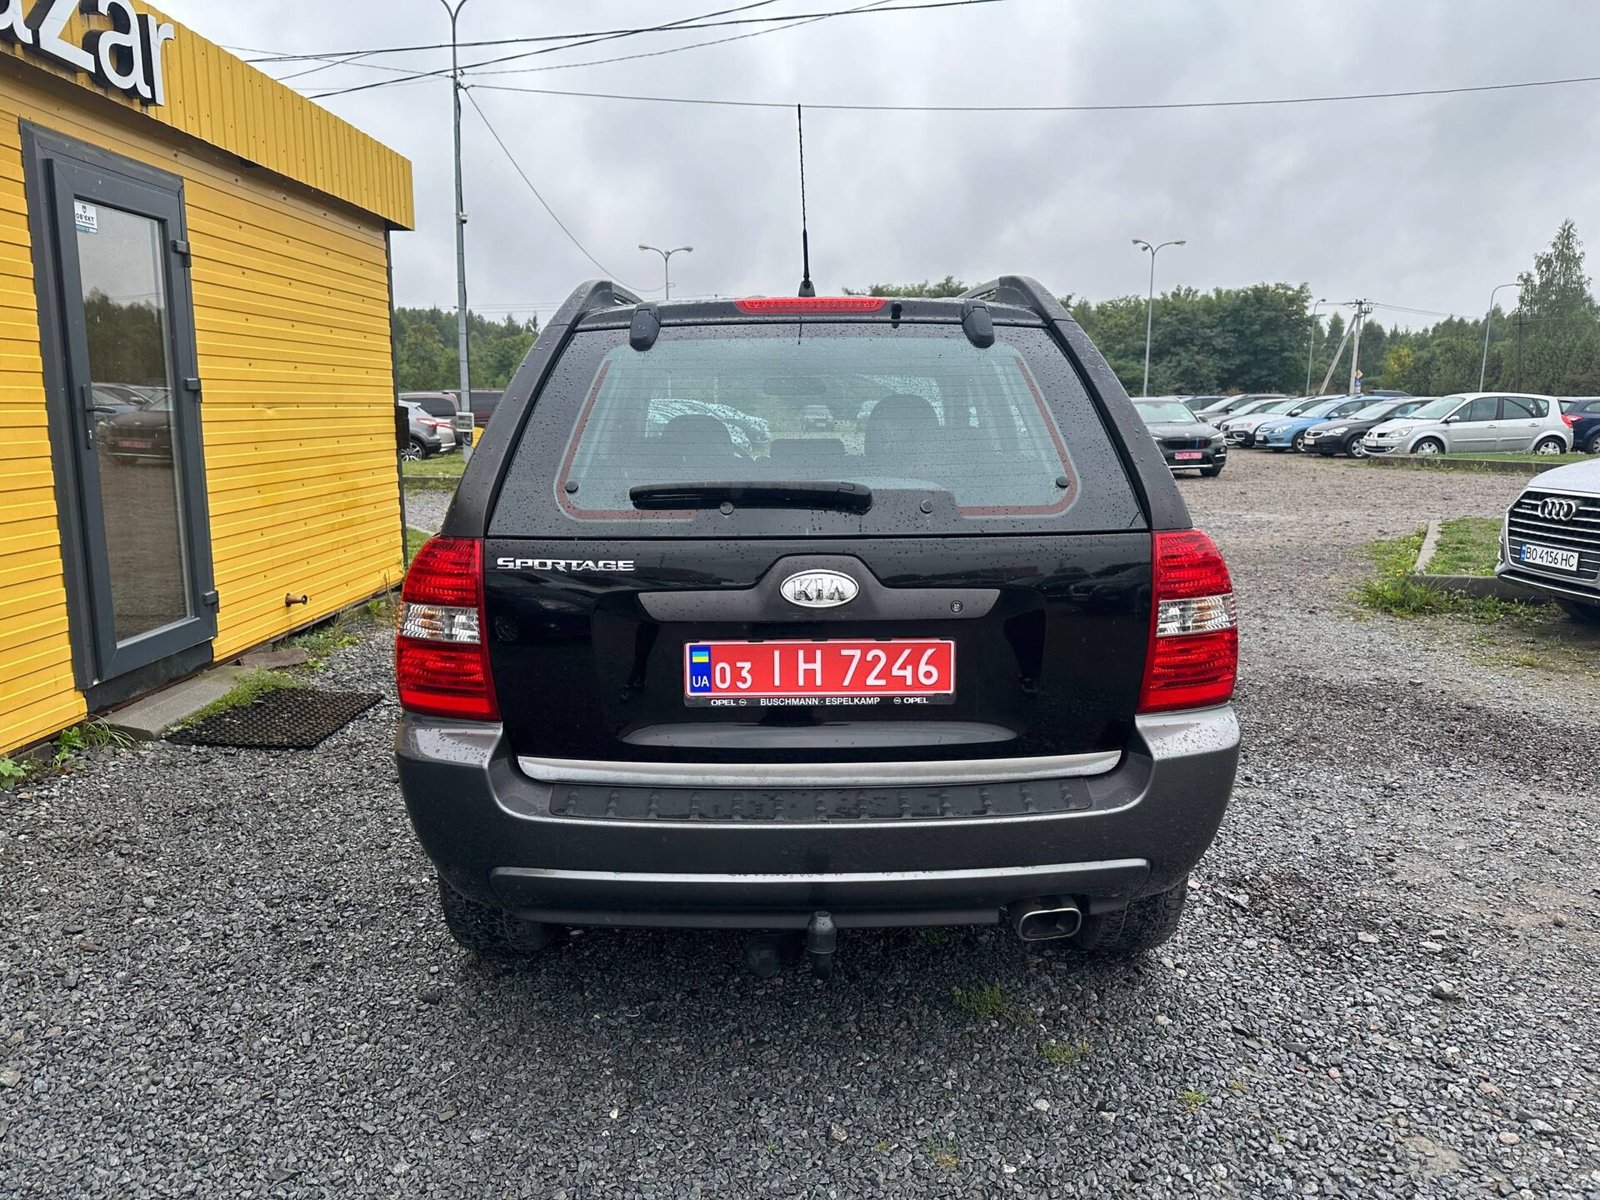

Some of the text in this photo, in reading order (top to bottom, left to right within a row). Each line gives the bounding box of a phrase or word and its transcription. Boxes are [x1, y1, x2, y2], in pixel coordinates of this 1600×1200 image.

[497, 557, 635, 572] SPORTAGE
[1539, 549, 1559, 565] 4156
[792, 578, 848, 601] KIA
[714, 661, 752, 689] 03
[840, 647, 939, 687] 7246
[692, 675, 710, 688] UA
[760, 697, 881, 706] BUSCHMANN ESPELKAMP
